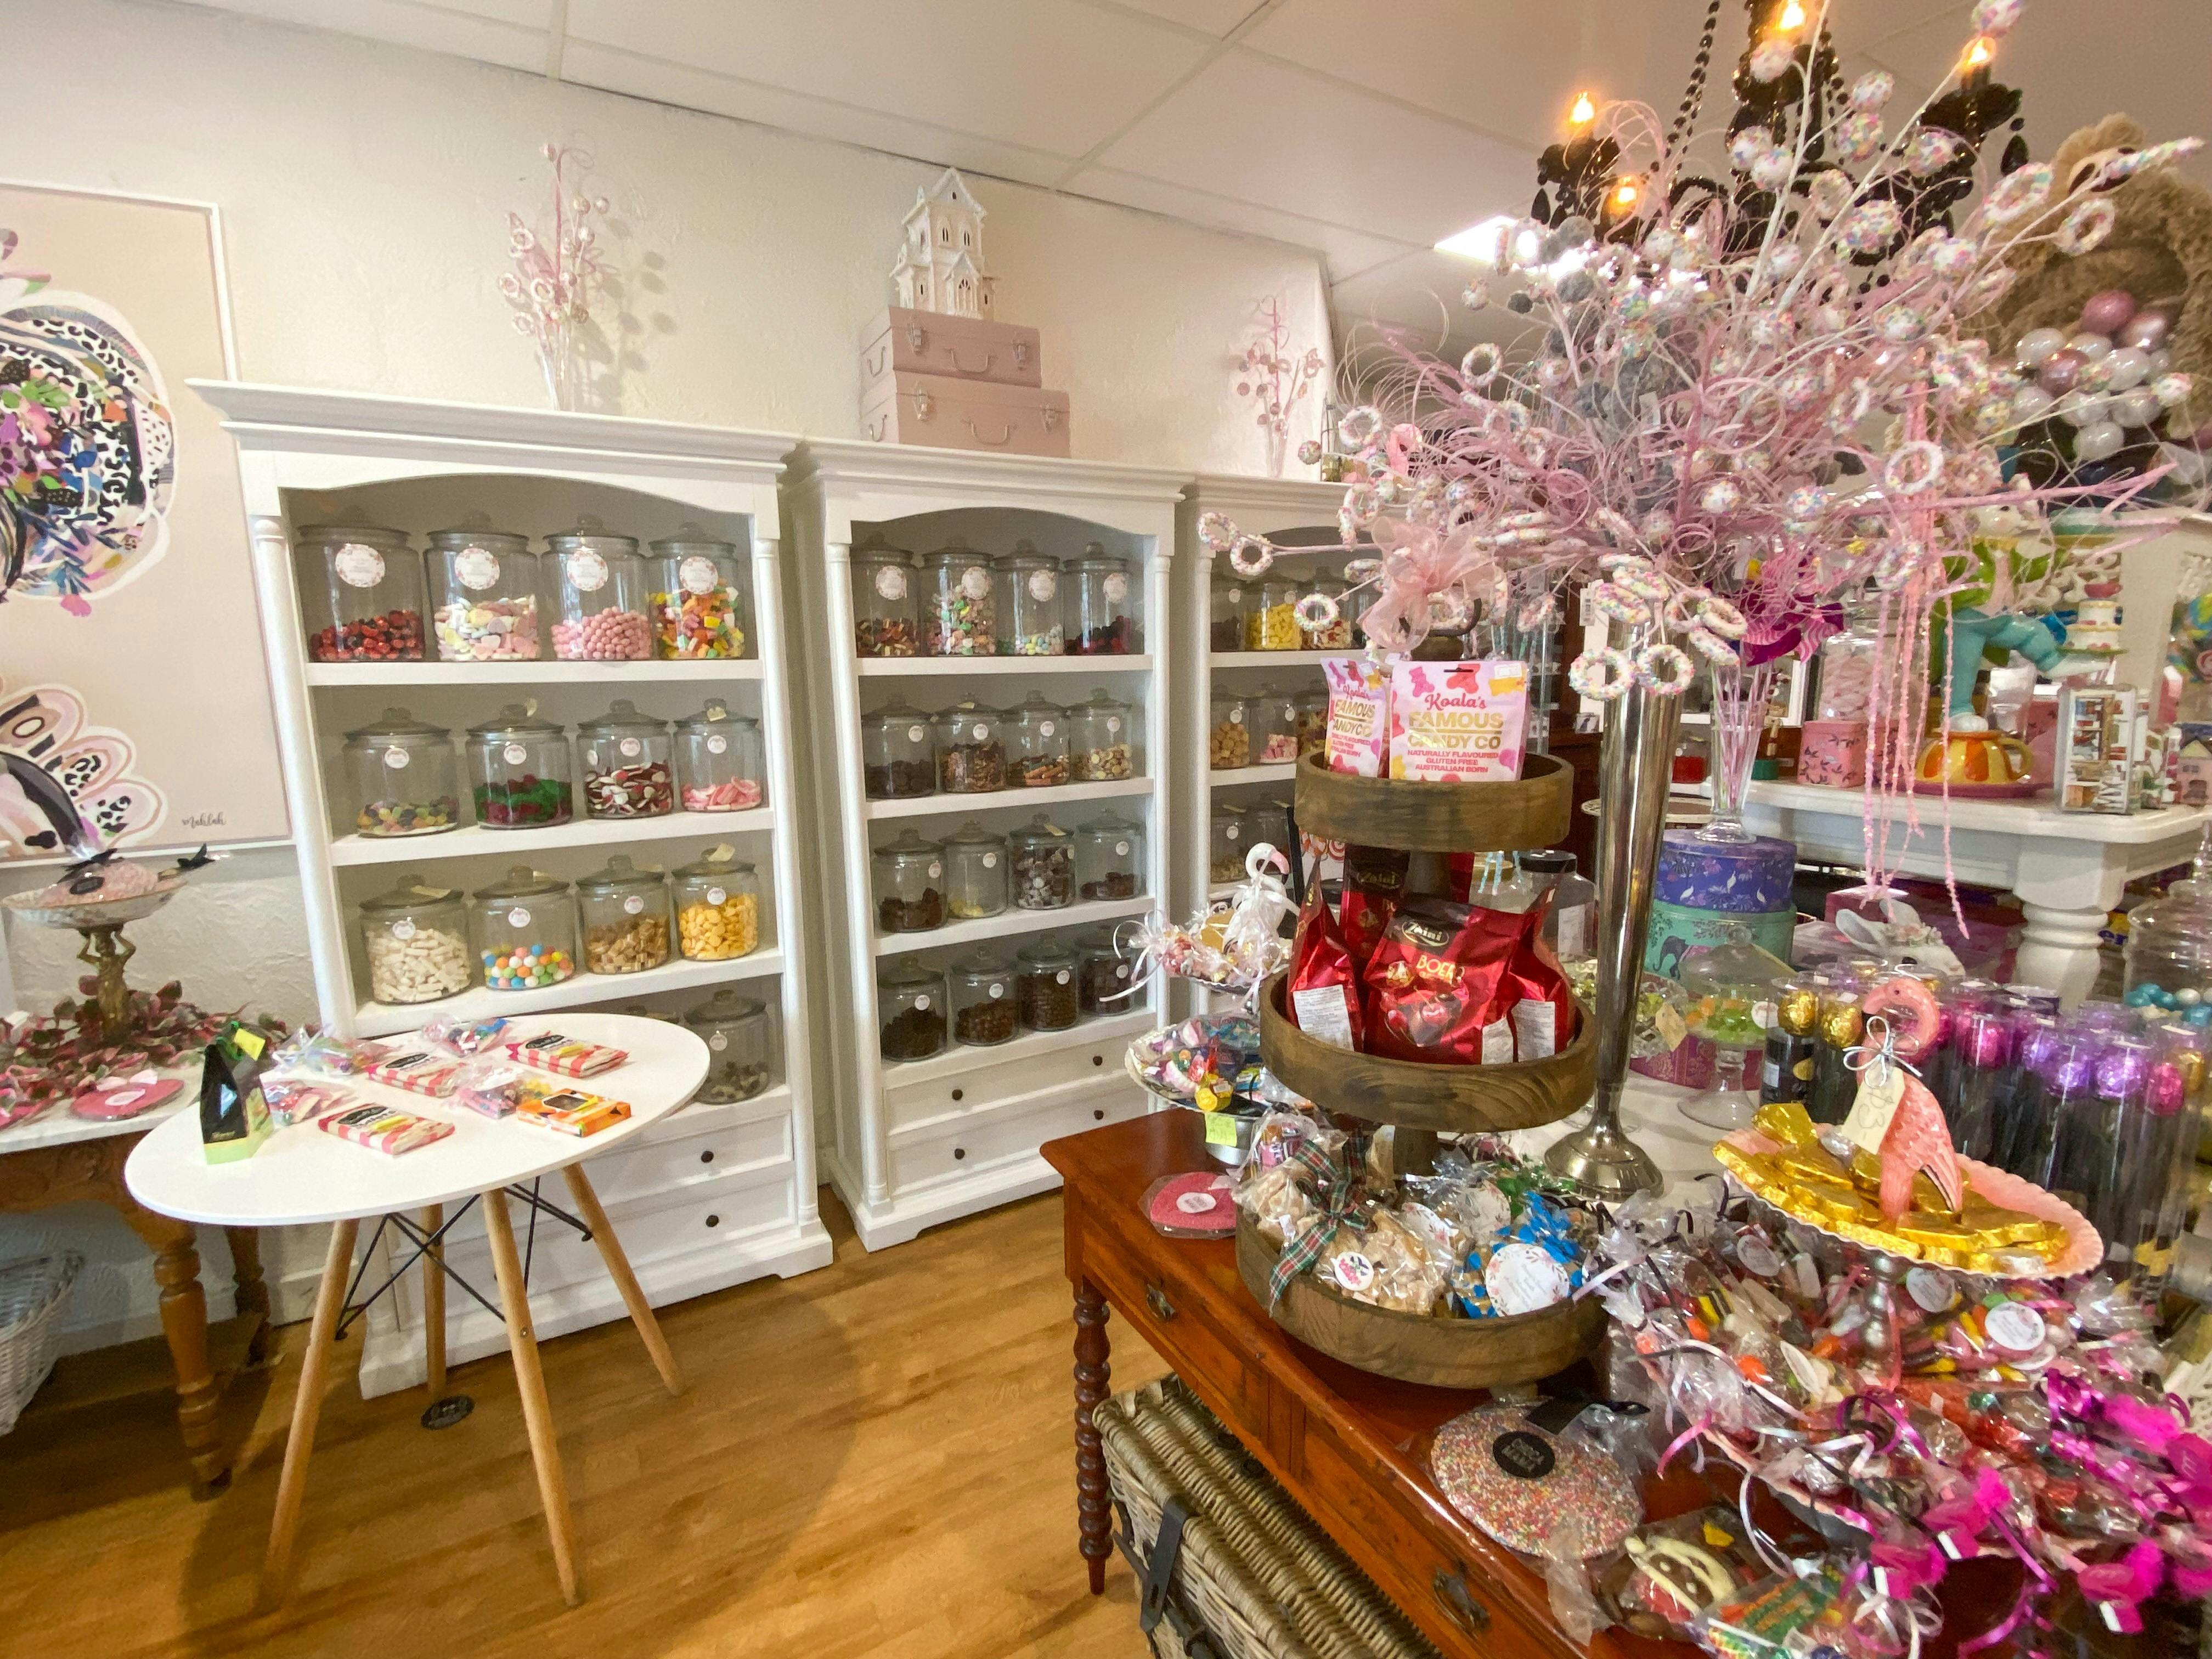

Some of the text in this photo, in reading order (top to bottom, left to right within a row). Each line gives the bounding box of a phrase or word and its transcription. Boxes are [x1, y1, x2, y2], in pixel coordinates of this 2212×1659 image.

[1335, 699, 1375, 718] FAMOUS
[1425, 692, 1487, 711] Koala's
[1408, 712, 1504, 729] FAMOUS
[1475, 736, 1502, 749] CO
[1415, 764, 1464, 772] AUSTRALIAN
[1404, 921, 1443, 941] Zaini
